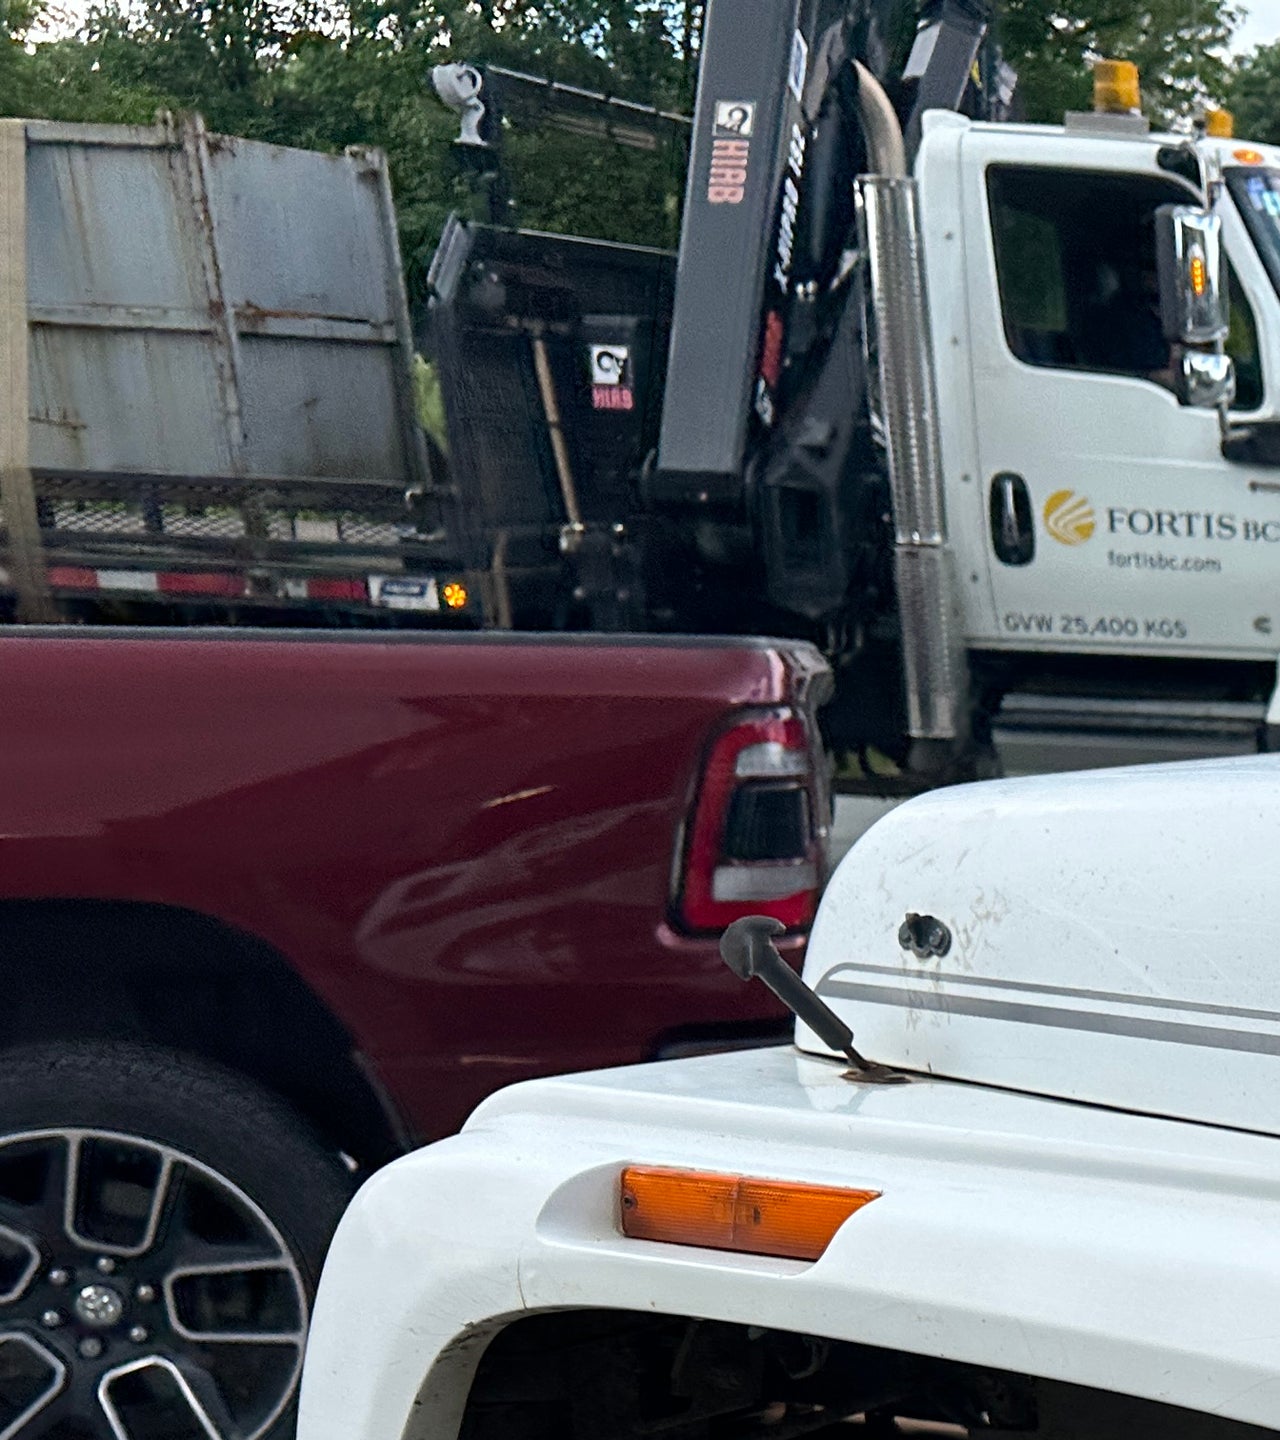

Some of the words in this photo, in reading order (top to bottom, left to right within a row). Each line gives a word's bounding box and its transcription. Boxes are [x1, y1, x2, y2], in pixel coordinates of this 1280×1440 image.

[708, 139, 750, 204] HIAB
[1107, 550, 1222, 573] fortisbc.com
[1004, 613, 1053, 634] GVW
[1061, 616, 1140, 637] 25,400
[1145, 619, 1188, 639] KGS
